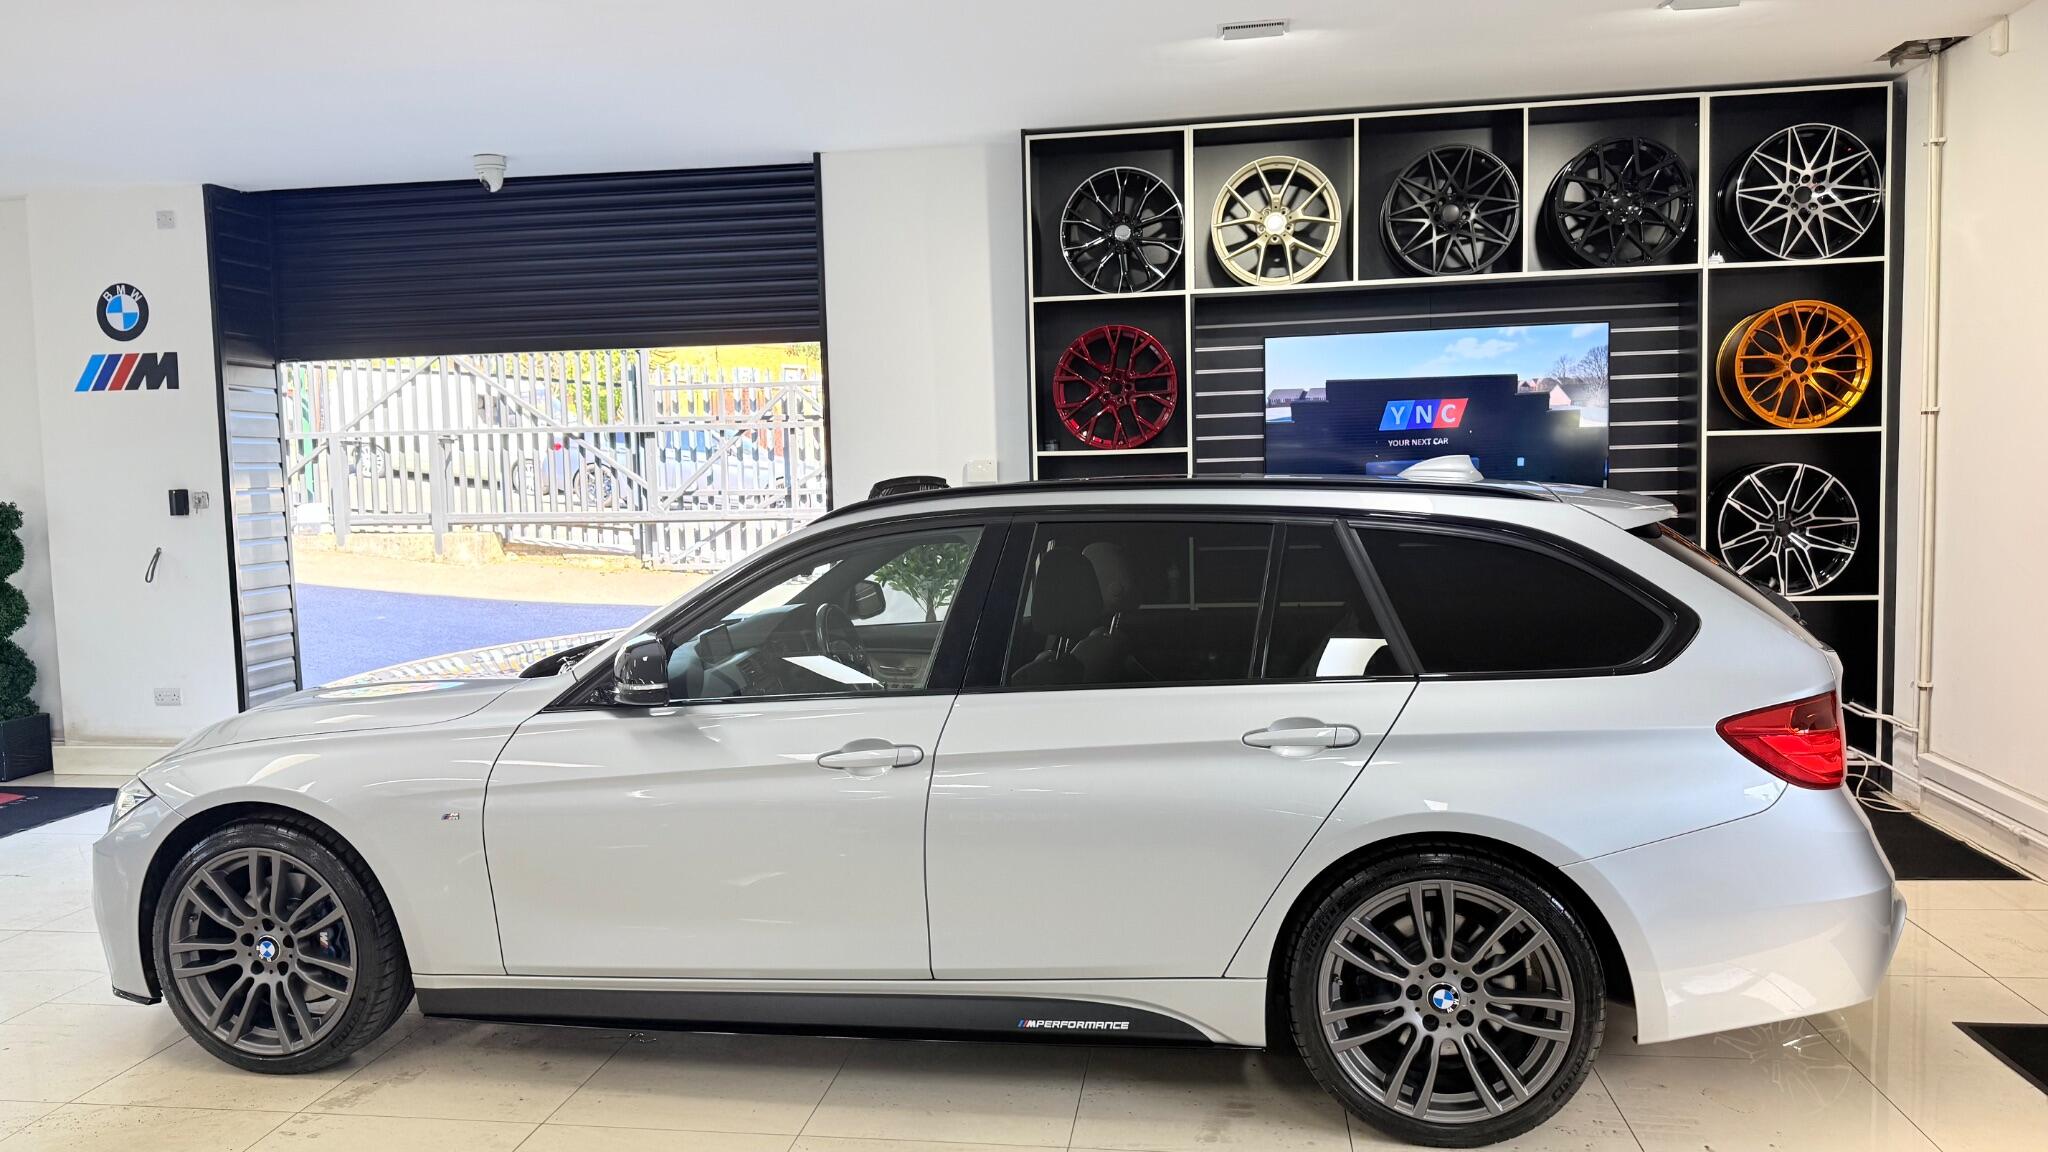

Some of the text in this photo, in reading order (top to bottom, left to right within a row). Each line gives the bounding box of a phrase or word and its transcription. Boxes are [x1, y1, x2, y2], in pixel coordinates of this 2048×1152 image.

[102, 284, 143, 302] BMW
[1390, 404, 1456, 425] YNC
[1387, 437, 1449, 447] YOUR NEXT CAR
